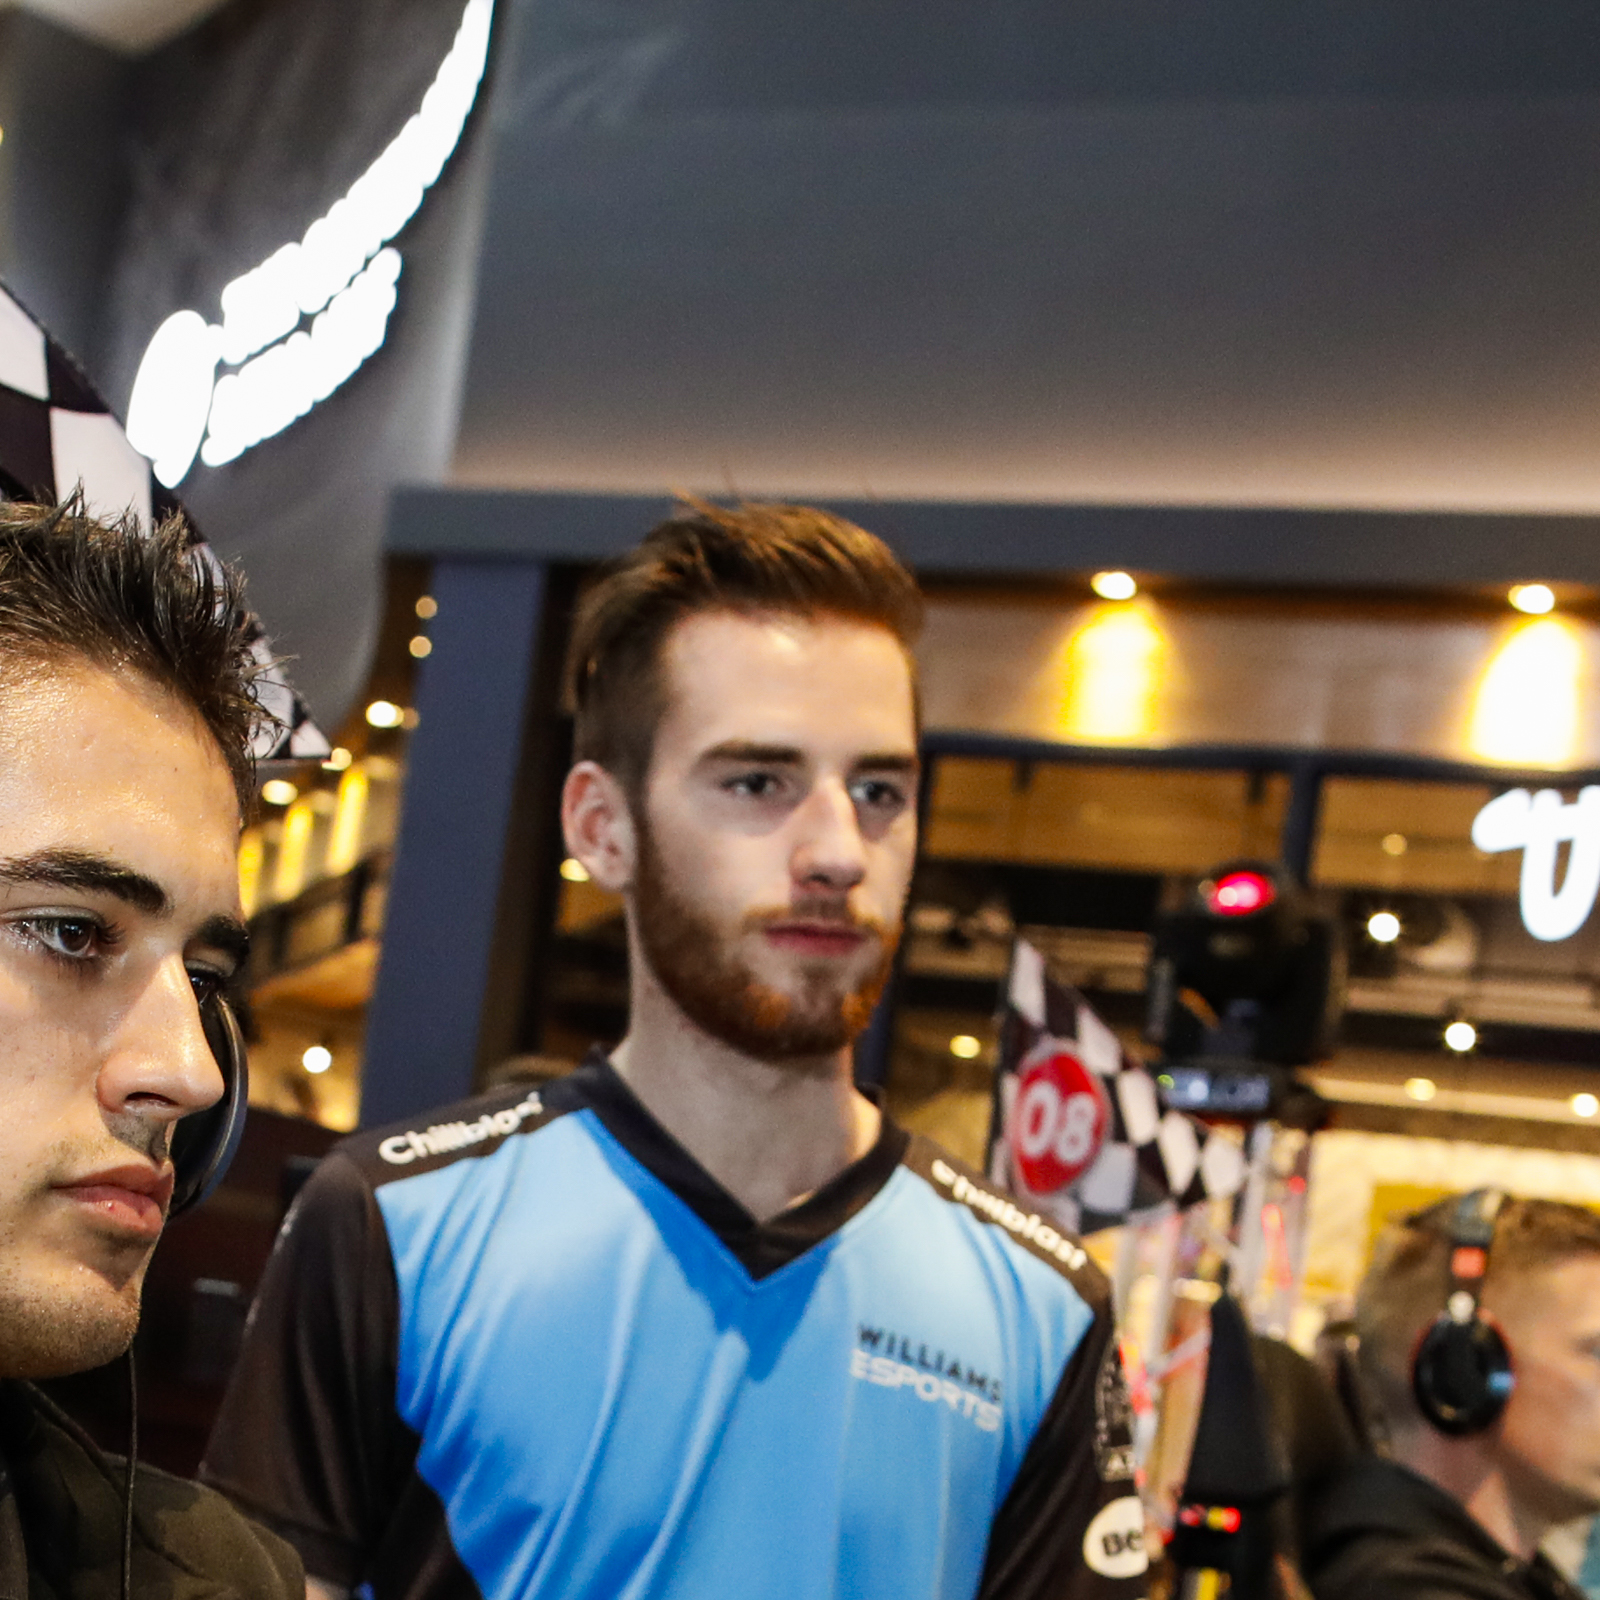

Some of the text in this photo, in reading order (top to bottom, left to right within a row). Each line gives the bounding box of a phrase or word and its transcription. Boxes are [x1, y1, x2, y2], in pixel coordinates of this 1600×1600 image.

[1019, 1081, 1097, 1163] 08
[850, 1350, 1002, 1431] ESPORTS
[857, 1323, 1002, 1403] WILLIAMS
